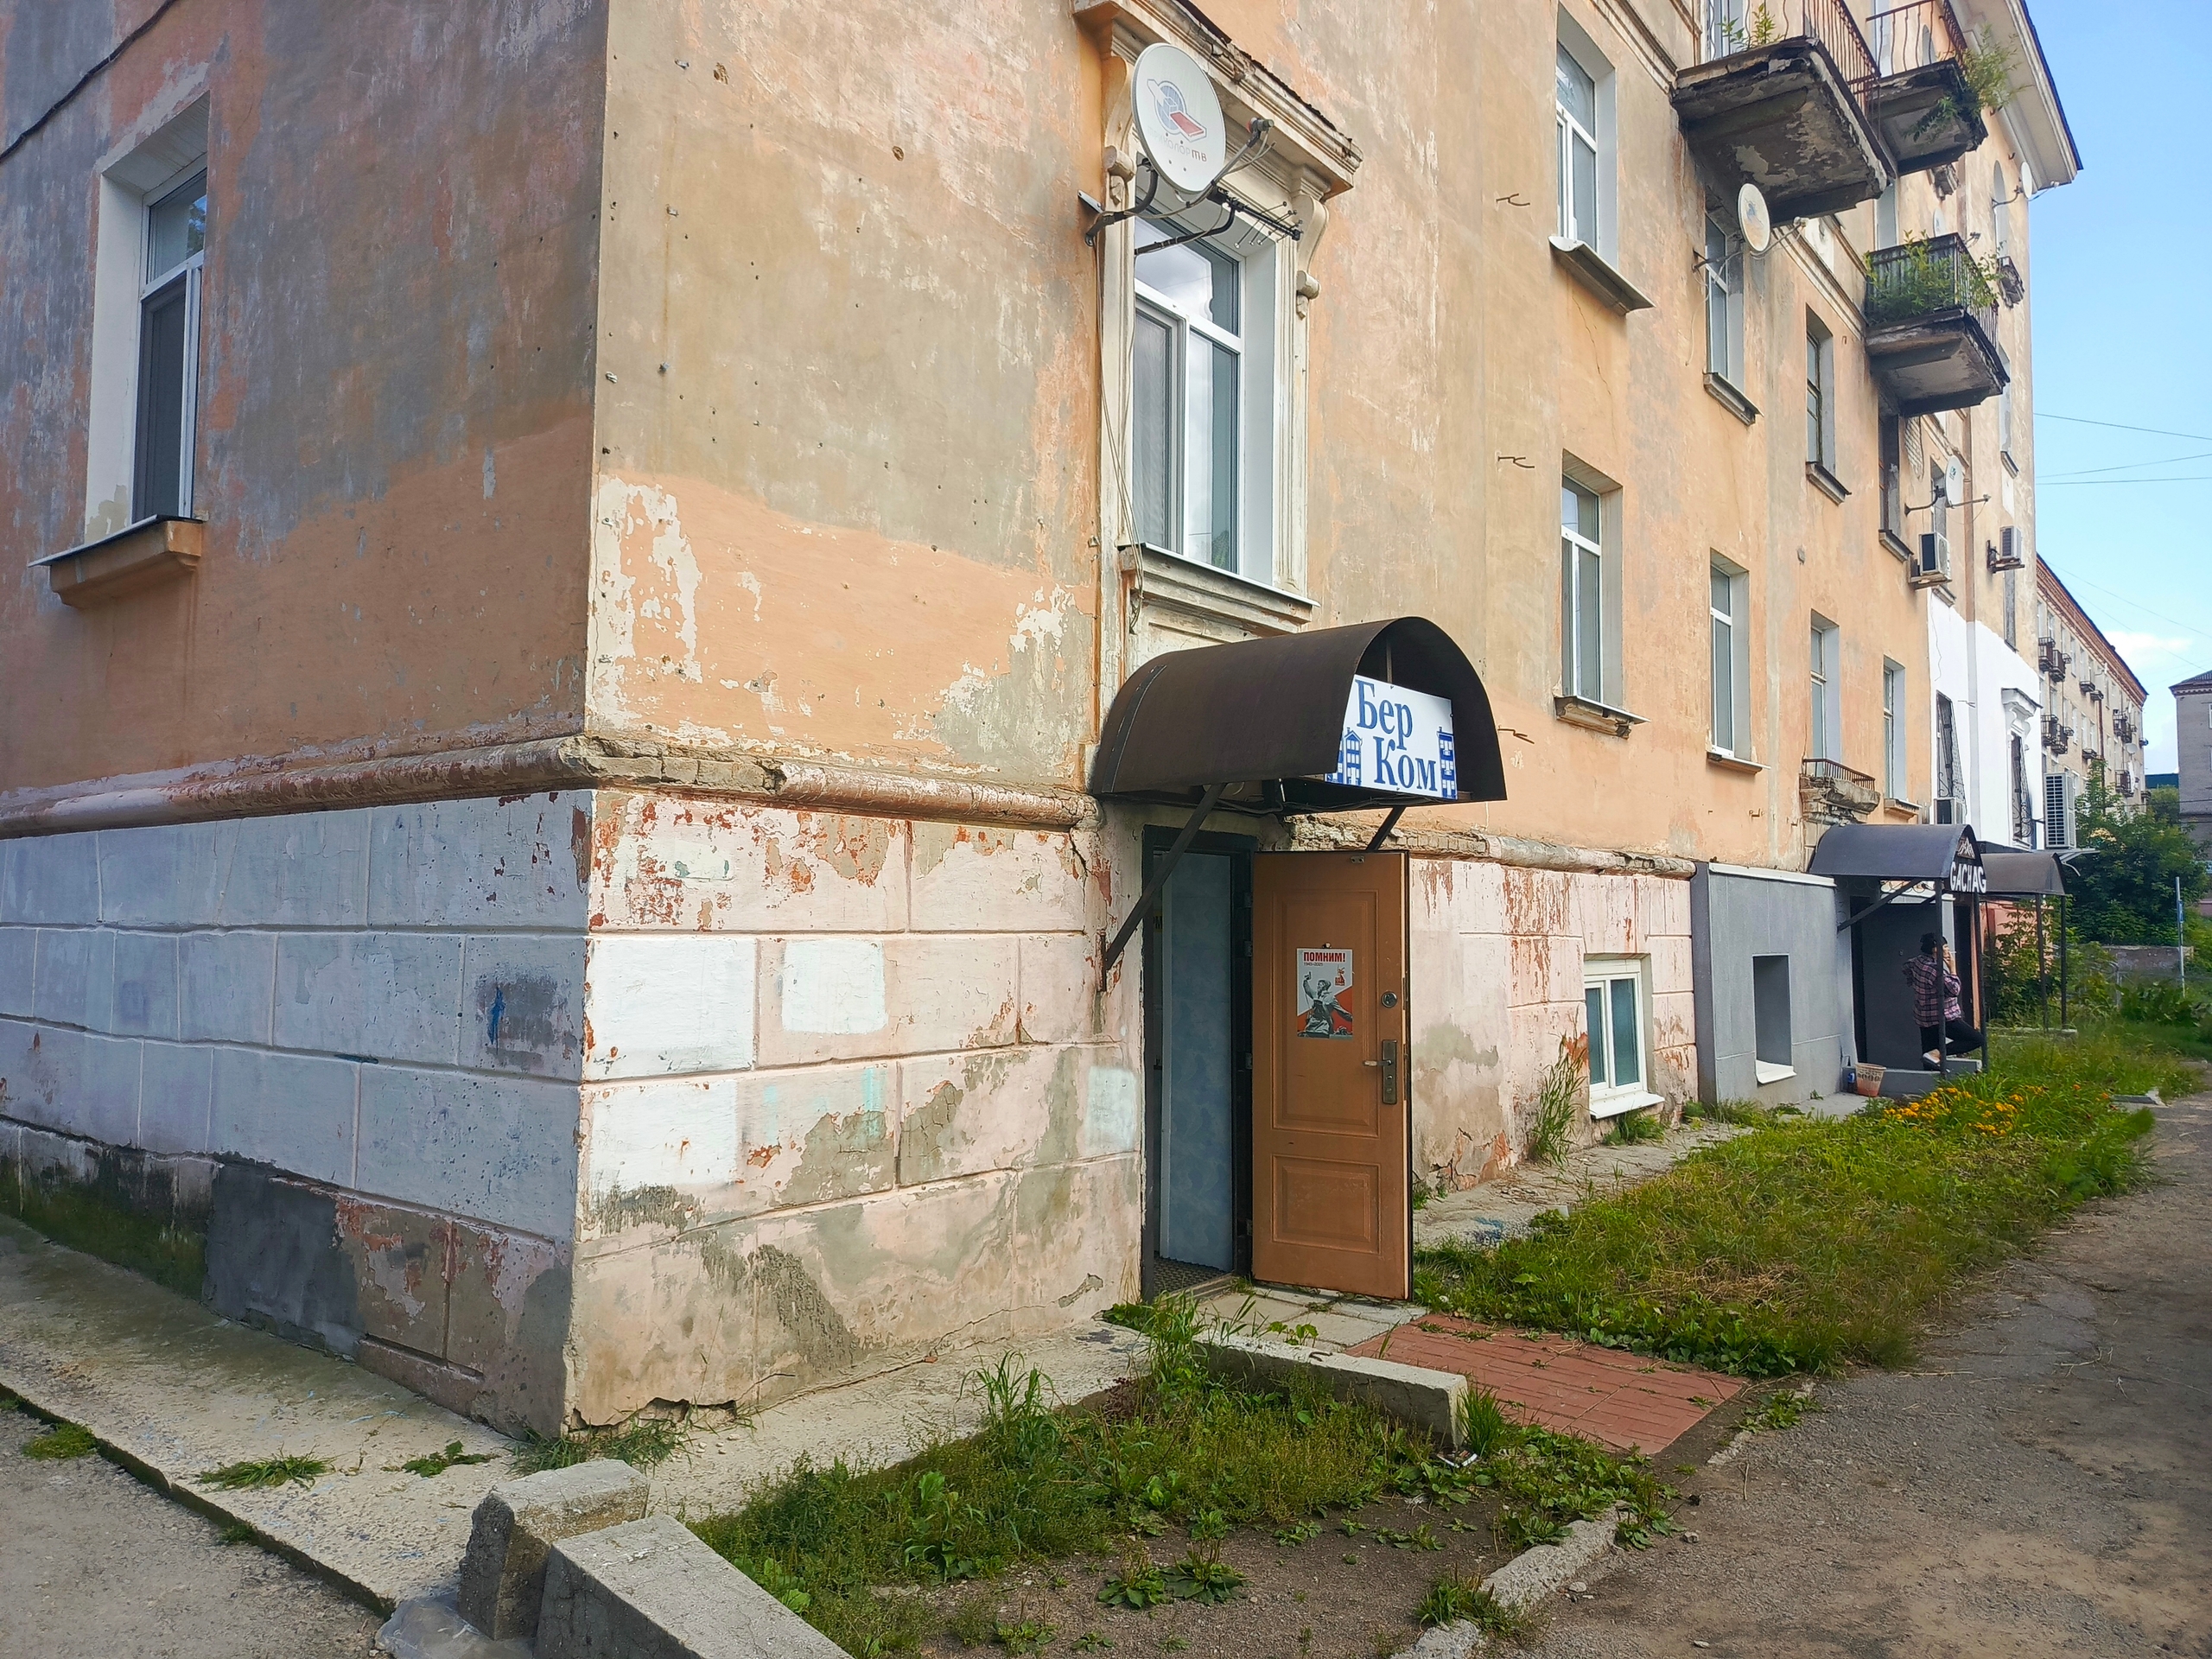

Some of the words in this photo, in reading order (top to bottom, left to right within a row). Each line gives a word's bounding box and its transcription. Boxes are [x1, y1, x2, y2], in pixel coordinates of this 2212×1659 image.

[1355, 679, 1413, 750] Бер
[1373, 736, 1438, 791] Ком
[1949, 861, 1986, 893] GACHAG
[1303, 951, 1345, 963] ПОМНИМ!
